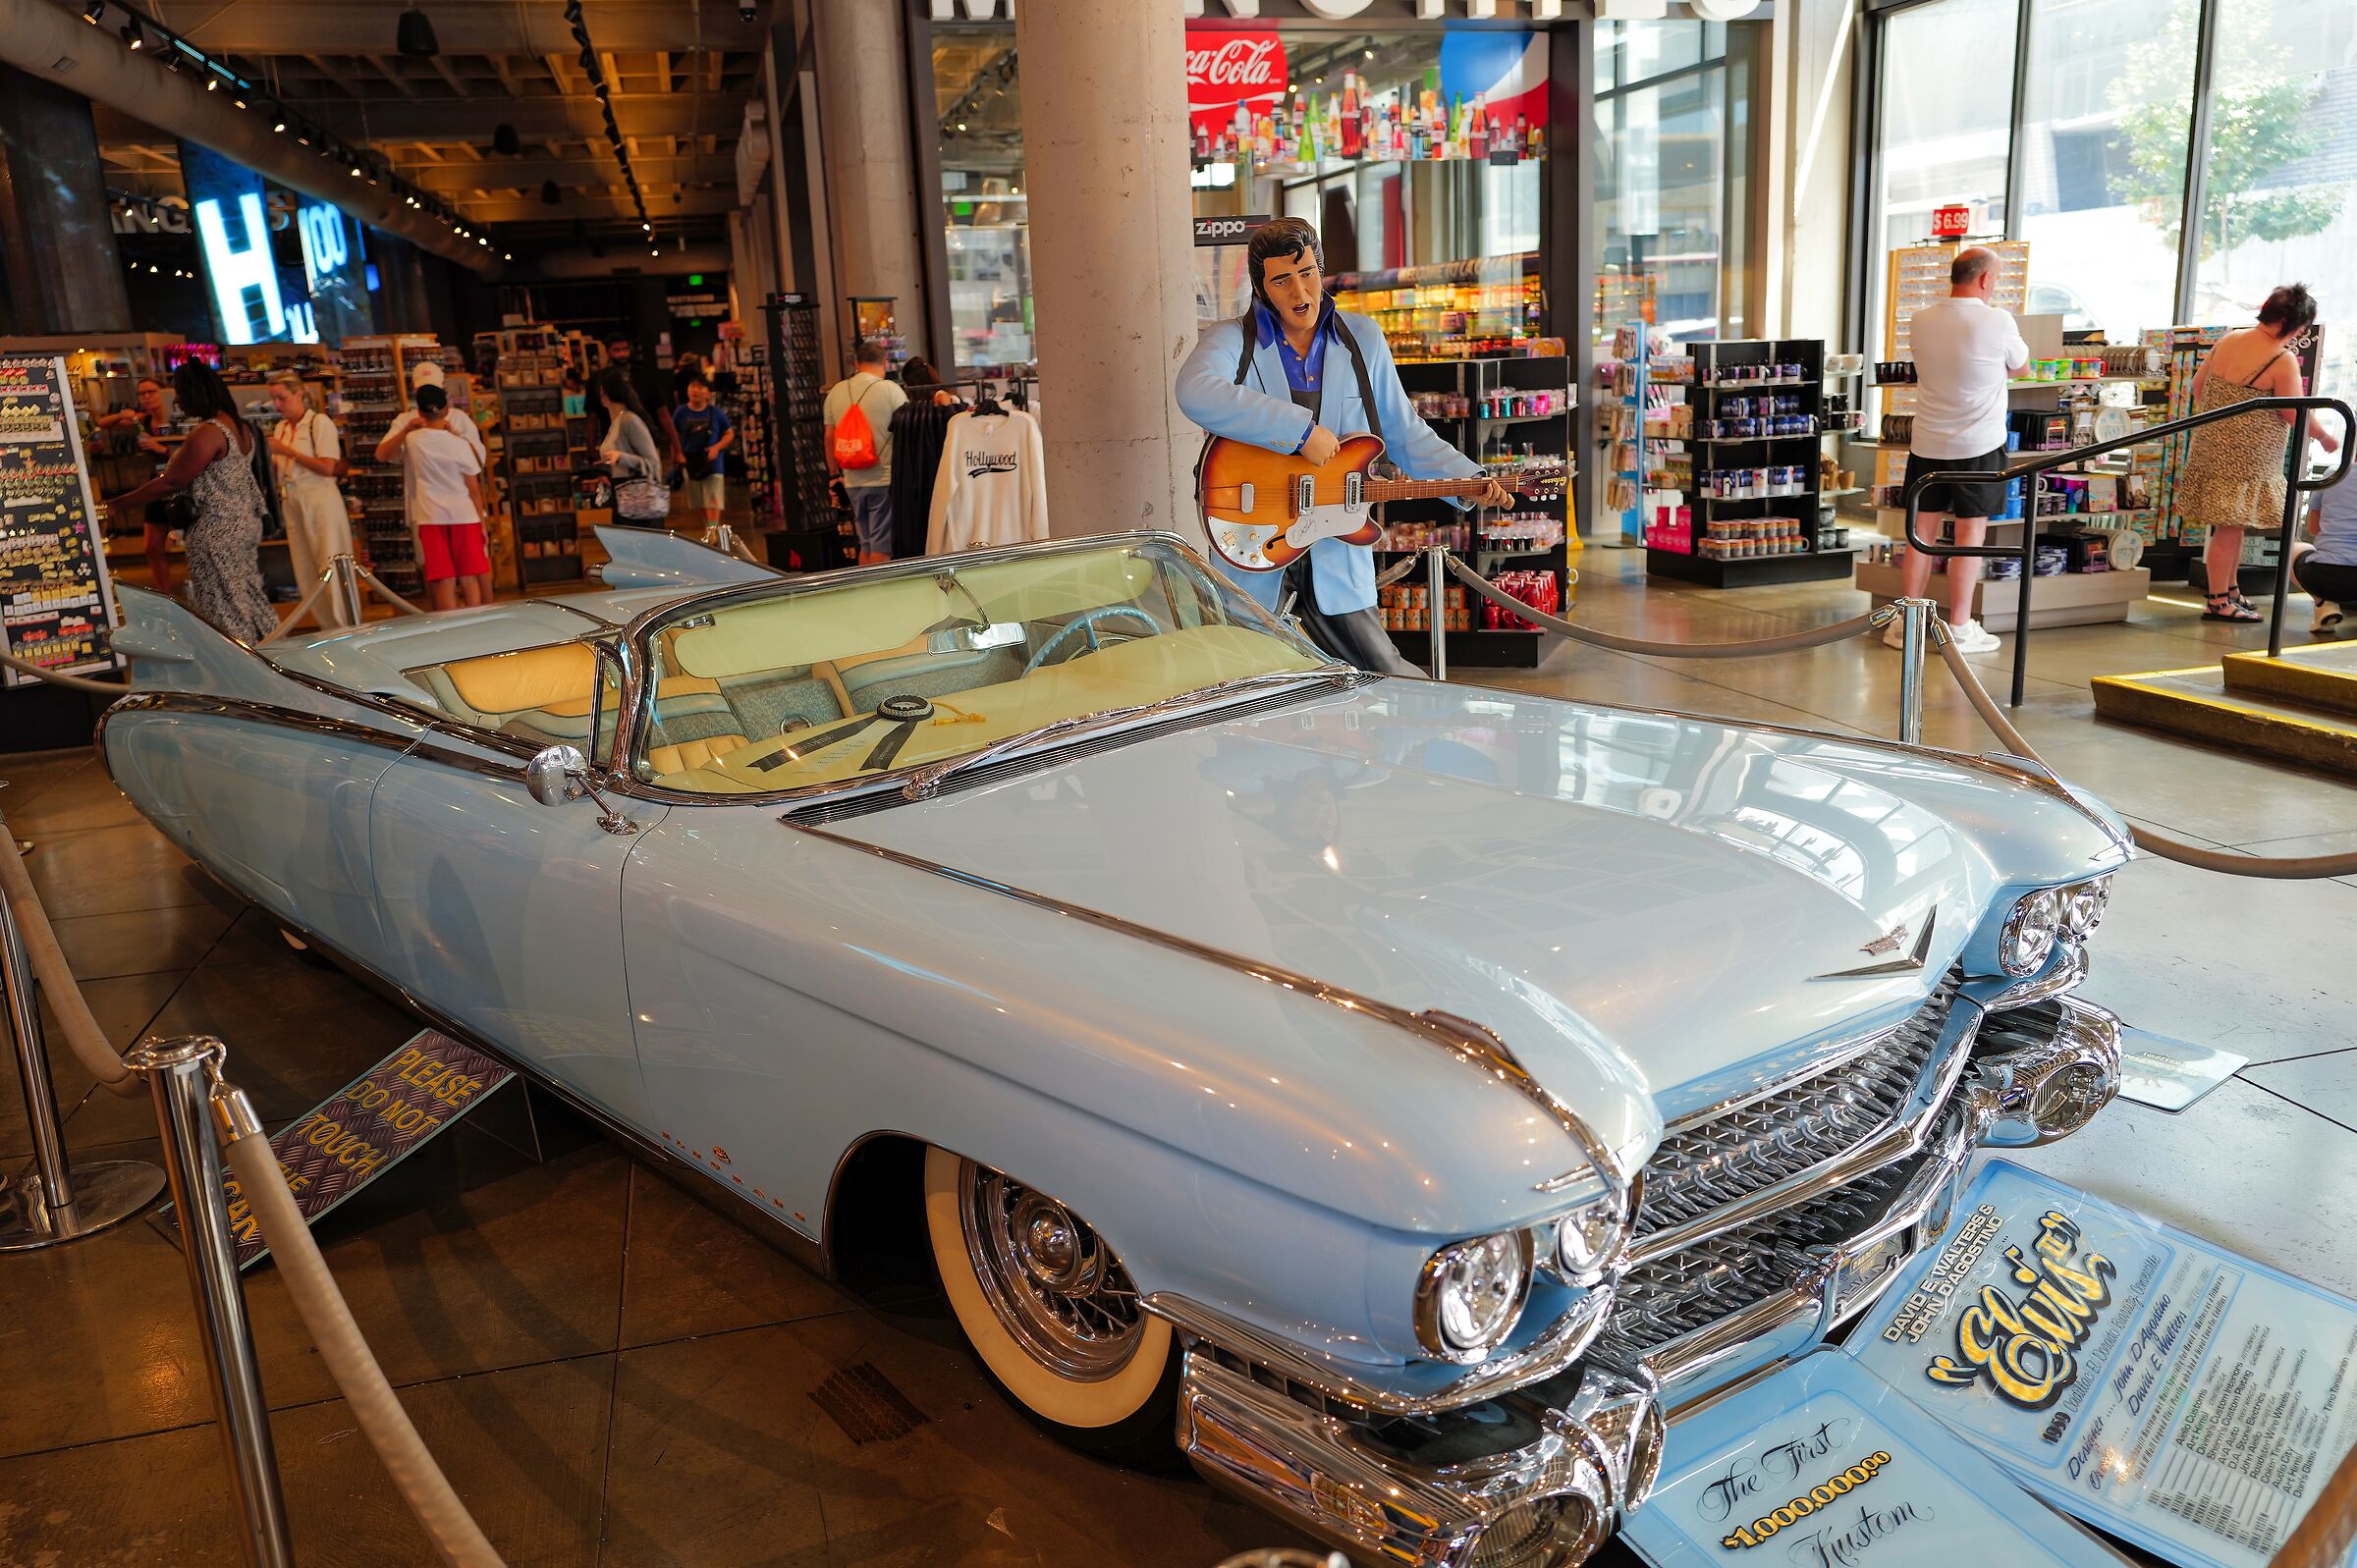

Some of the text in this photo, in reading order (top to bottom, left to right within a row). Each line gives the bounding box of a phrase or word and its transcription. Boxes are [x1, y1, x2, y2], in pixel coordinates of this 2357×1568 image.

[1195, 219, 1246, 238] zippo
[965, 451, 1016, 468] Hollywood
[387, 1049, 484, 1108] PLEASE
[344, 1080, 442, 1138] DO NOT
[297, 1113, 389, 1177] TOUCH
[1882, 1202, 1997, 1345] DAVID E. WALTERS &
[1906, 1215, 2005, 1344] JOHN D'AGOSTINO
[2043, 1409, 2073, 1445] 1959
[2062, 1372, 2096, 1414] Cadillac
[2091, 1357, 2104, 1377] El
[2098, 1325, 2121, 1364] Dorado
[2112, 1363, 2135, 1403] John
[2127, 1370, 2156, 1417] David
[2150, 1353, 2164, 1373] E.
[2160, 1309, 2187, 1360] Walters
[2186, 1386, 2209, 1424] Customs
[2208, 1425, 2228, 1460] Sherm's
[2222, 1394, 2242, 1427] Custom
[2236, 1368, 2254, 1396] Plating
[2211, 1391, 2231, 1425] Custom
[2225, 1360, 2245, 1394] Interiors
[2237, 1425, 2254, 1451] Stone
[2247, 1390, 2268, 1426] Electrics
[2186, 1433, 2199, 1450] Art
[2226, 1425, 2241, 1447] Auto
[2240, 1451, 2255, 1474] John
[2250, 1438, 2273, 1479] Roadster
[2267, 1419, 2280, 1440] Wire
[2275, 1389, 2292, 1420] Wheels
[2262, 1457, 2278, 1485] Coker
[2272, 1434, 2286, 1457] Tires
[2304, 1449, 2319, 1474] Glass
[1696, 1418, 1851, 1523] The First
[2272, 1462, 2288, 1487] Audio
[2281, 1445, 2295, 1464] City
[2283, 1476, 2296, 1493] Art
[1786, 1500, 1935, 1568] Kustom
